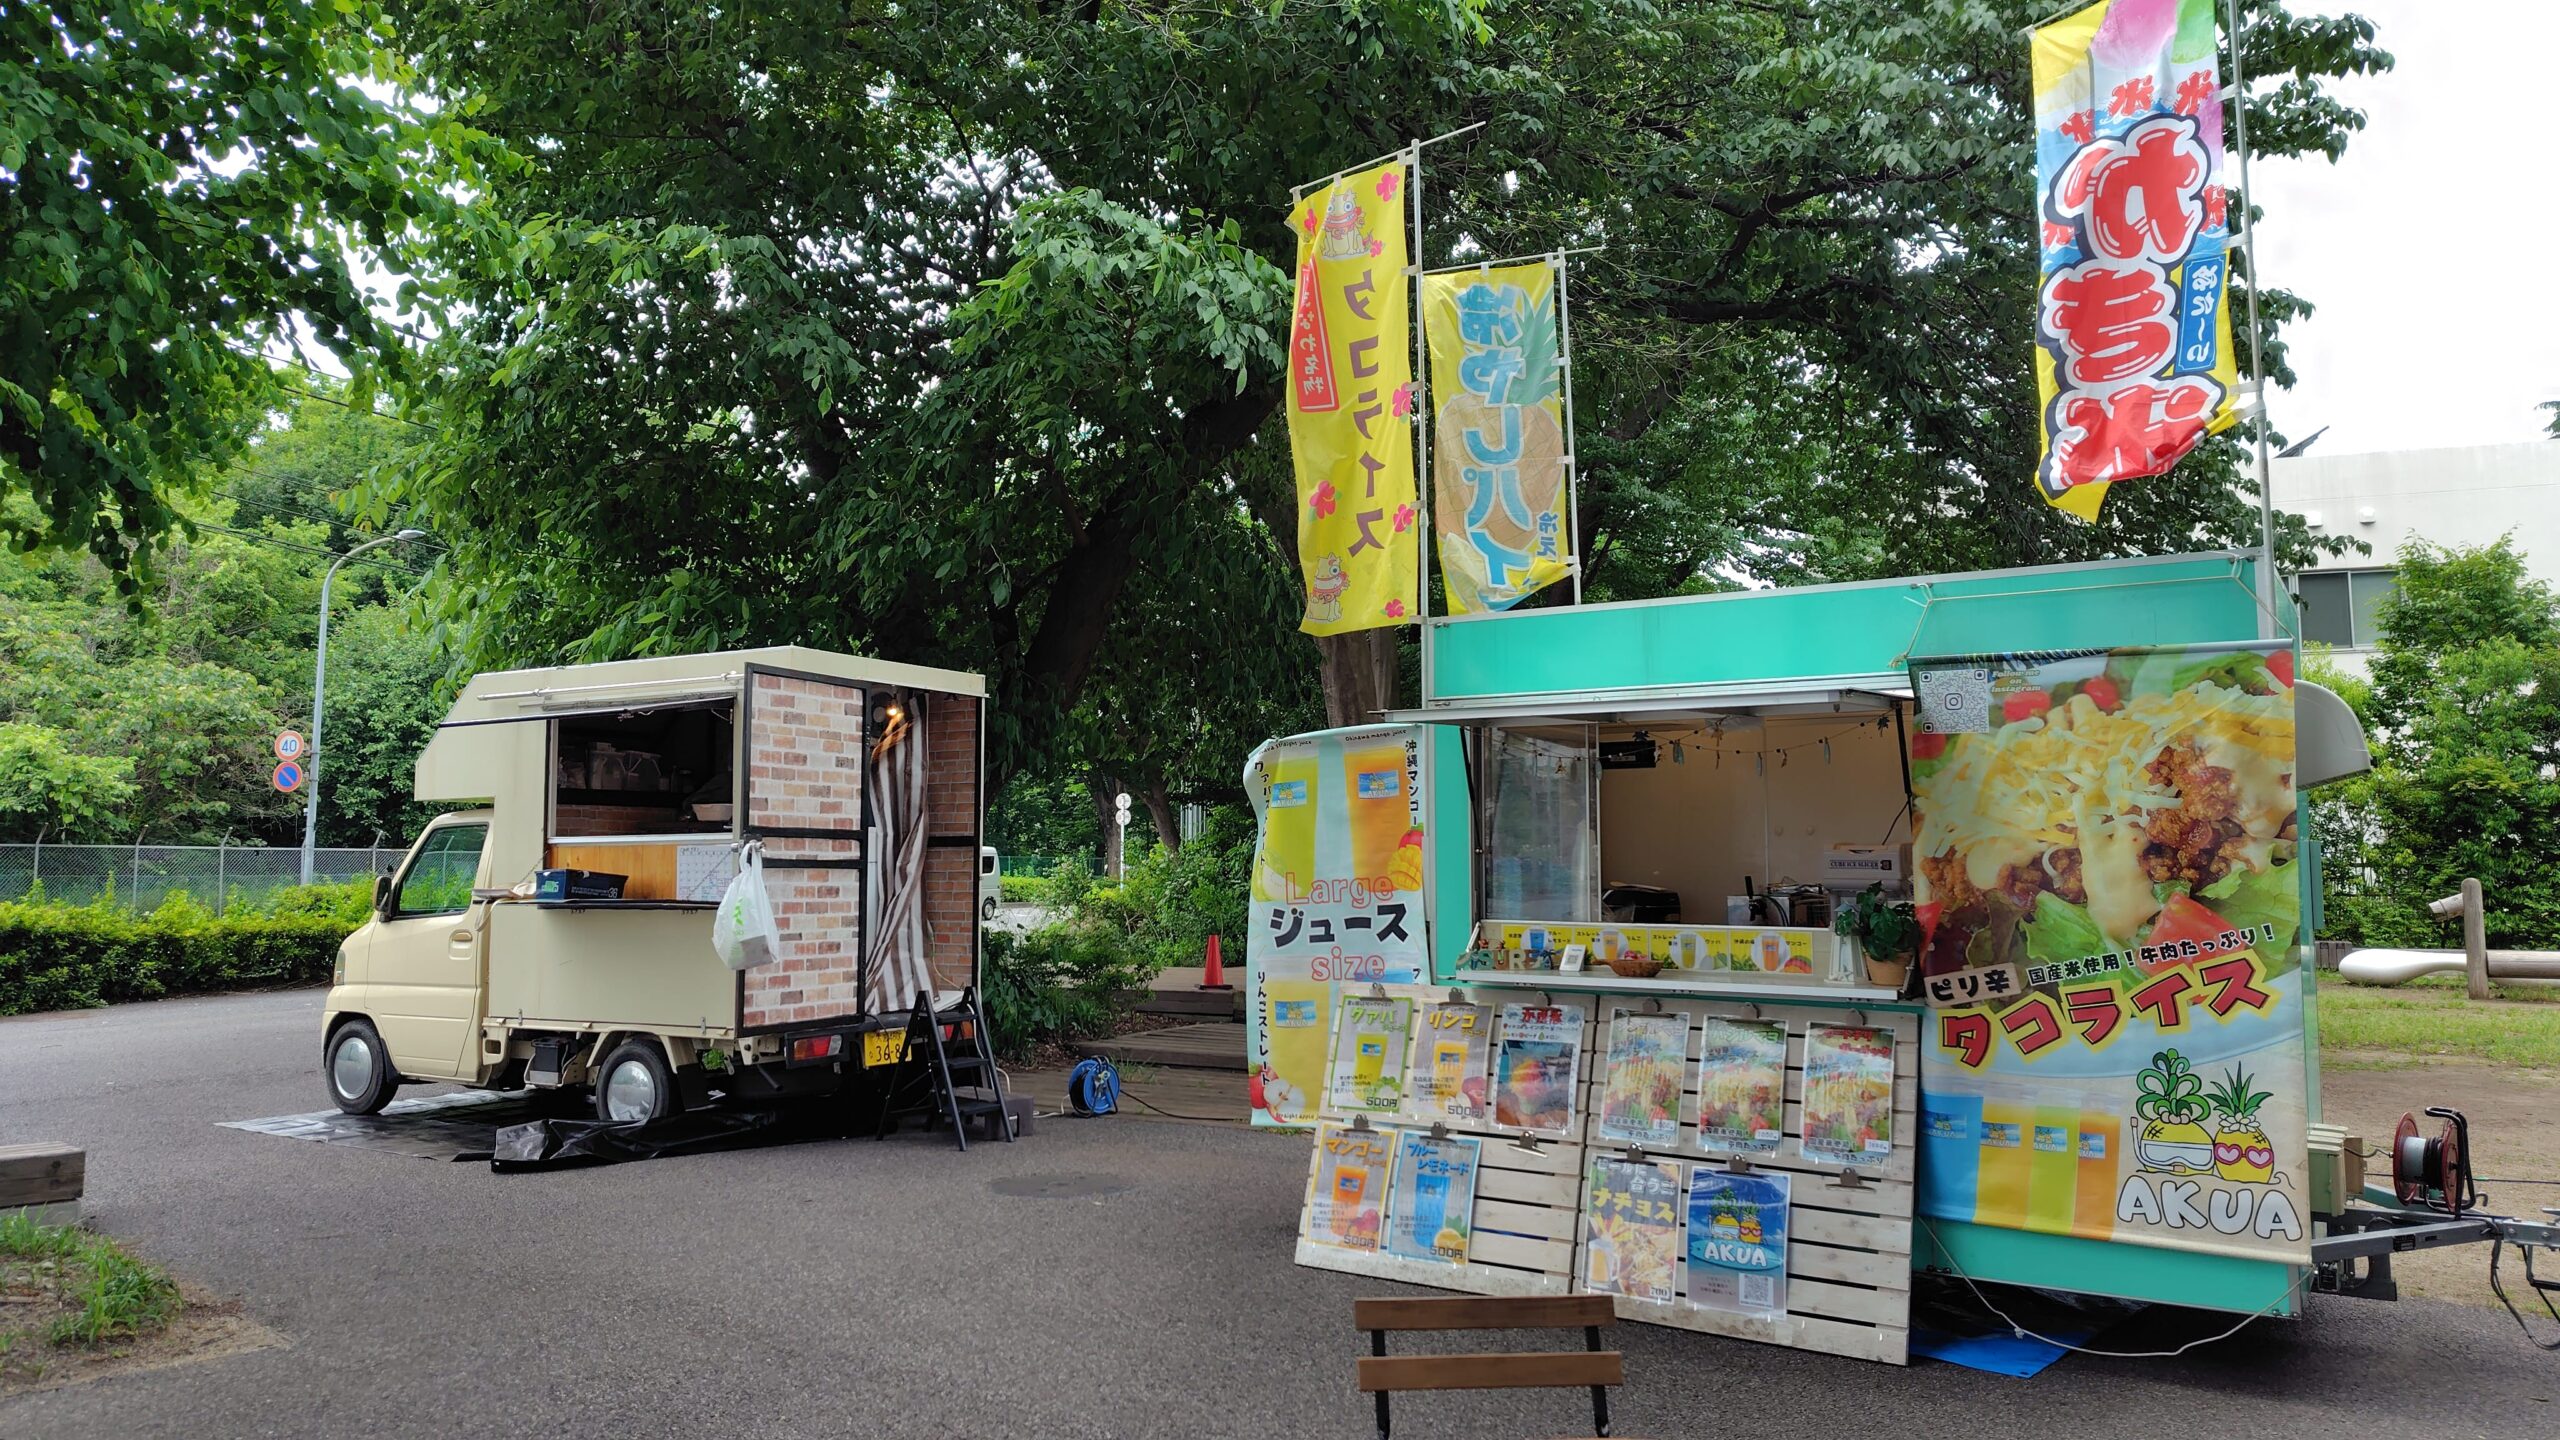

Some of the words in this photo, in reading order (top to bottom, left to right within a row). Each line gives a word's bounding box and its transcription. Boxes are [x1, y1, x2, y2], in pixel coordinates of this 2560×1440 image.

[281, 739, 298, 752] 40
[1405, 739, 1420, 827] 沖縄マンゴー
[1284, 871, 1394, 908] Large
[1269, 902, 1409, 948] ジュース
[1311, 946, 1386, 982] size
[1930, 969, 2013, 1004] ピリ辛
[1257, 971, 1271, 1087] りんごストレート
[1428, 1011, 1479, 1030] リンゴ
[1942, 955, 2270, 1068] タコライス
[876, 1043, 901, 1062] 36-8
[1366, 1096, 1398, 1108] 500円
[1416, 1158, 1471, 1175] レモネード
[1596, 1158, 1648, 1176] ビールに
[1591, 1186, 1677, 1224] ナチョス
[2116, 1174, 2305, 1242] AKUA
[1429, 1244, 1465, 1260] 500円
[1703, 1241, 1768, 1268] AKUA
